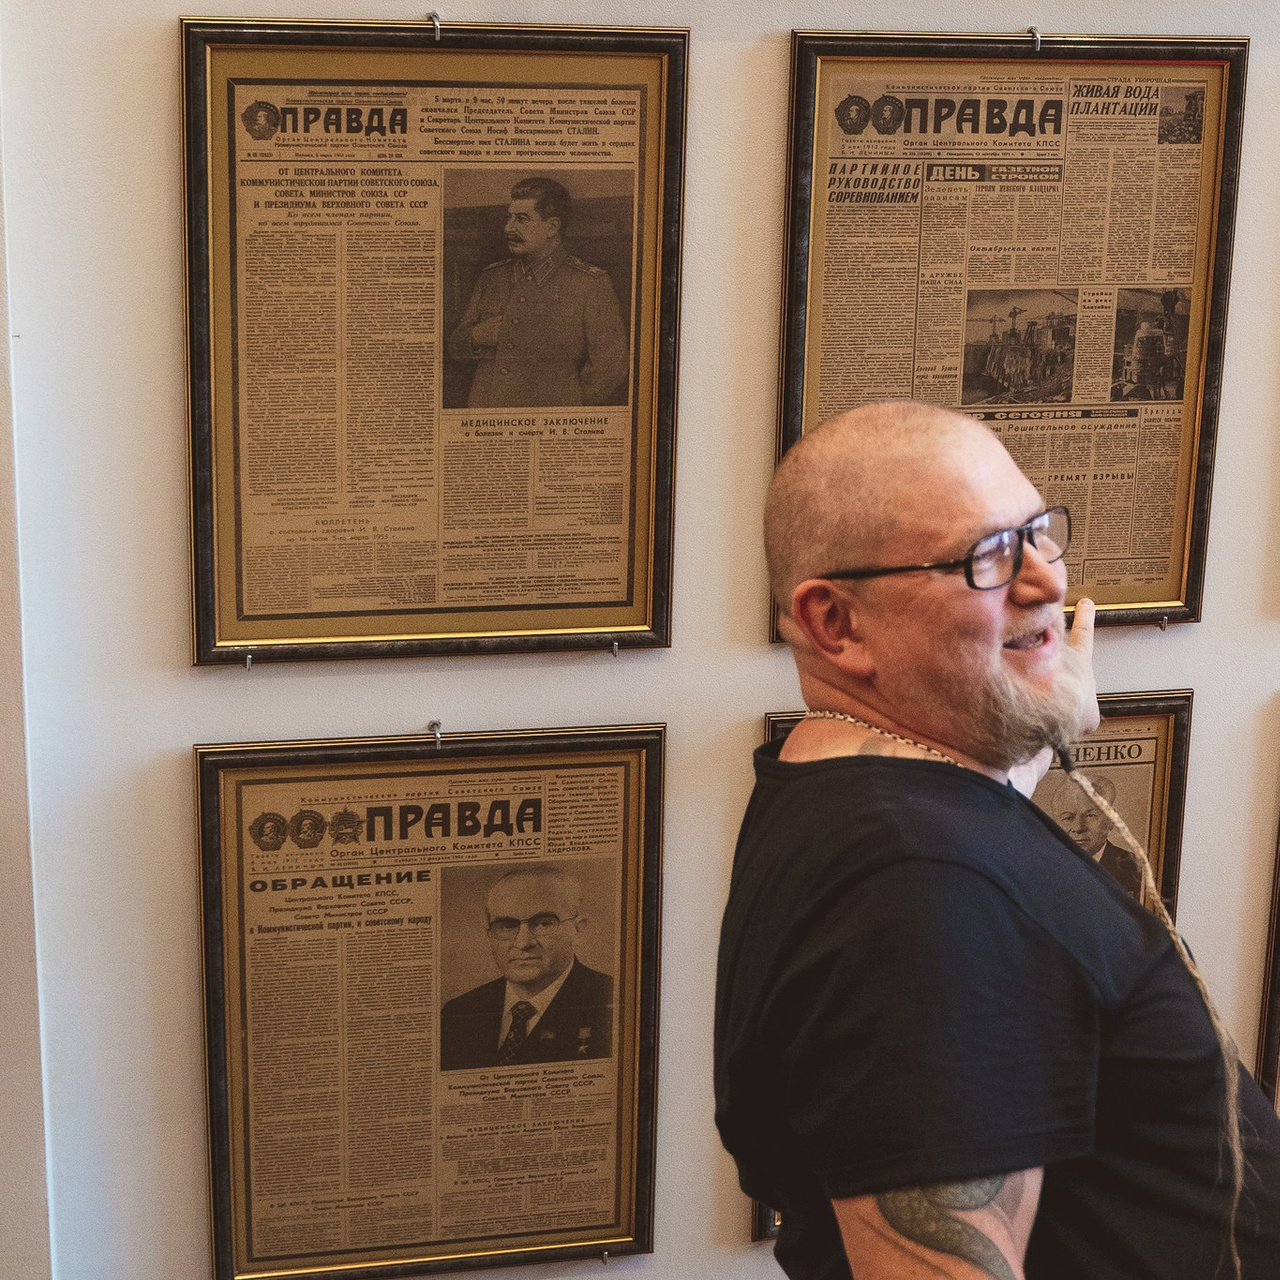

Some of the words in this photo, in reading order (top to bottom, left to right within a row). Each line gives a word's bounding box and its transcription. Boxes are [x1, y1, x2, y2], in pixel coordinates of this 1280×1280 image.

[1072, 85, 1121, 99] ЖИВАЯ
[1124, 86, 1160, 100] ВОДА
[1069, 101, 1158, 117] ПЛАНТАЦИИ
[280, 106, 407, 137] ПРАВДА
[904, 98, 1063, 137] ПРАВДА
[903, 140, 929, 149] Орган
[932, 140, 988, 149] Центрального
[993, 140, 1033, 149] Комитета
[1035, 140, 1060, 149] КПСС
[294, 168, 355, 176] ЦЕНТРАЛЬНОГО
[361, 168, 402, 176] КОМИТЕТА
[930, 167, 980, 181] ДЕНЬ
[827, 177, 920, 190] РУКОВОДСТВО
[309, 190, 356, 198] МИНИСТРОВ
[361, 190, 388, 198] СОЮЗА
[394, 190, 408, 198] ССР
[827, 191, 919, 204] СОРЕВНОВАНИЕМ
[265, 201, 317, 209] ПРЕЗИДИУМА
[970, 245, 1025, 254] Октябрьская
[994, 411, 1083, 419] сегодня
[461, 419, 536, 428] МЕДИЦИНСКОЕ
[544, 417, 608, 426] ЗАКЛЮЧЕНИЕ
[1007, 424, 1076, 432] Решительное
[1081, 423, 1137, 431] осуждение
[1093, 473, 1134, 481] ВЗРЫВЫ
[366, 798, 542, 842] ПРАВДА
[330, 849, 364, 858] Орган
[370, 845, 446, 856] Центрального
[453, 842, 503, 852] Комитета
[508, 838, 541, 849] КПСС
[249, 870, 431, 892] ОБРАЩЕНИЕ
